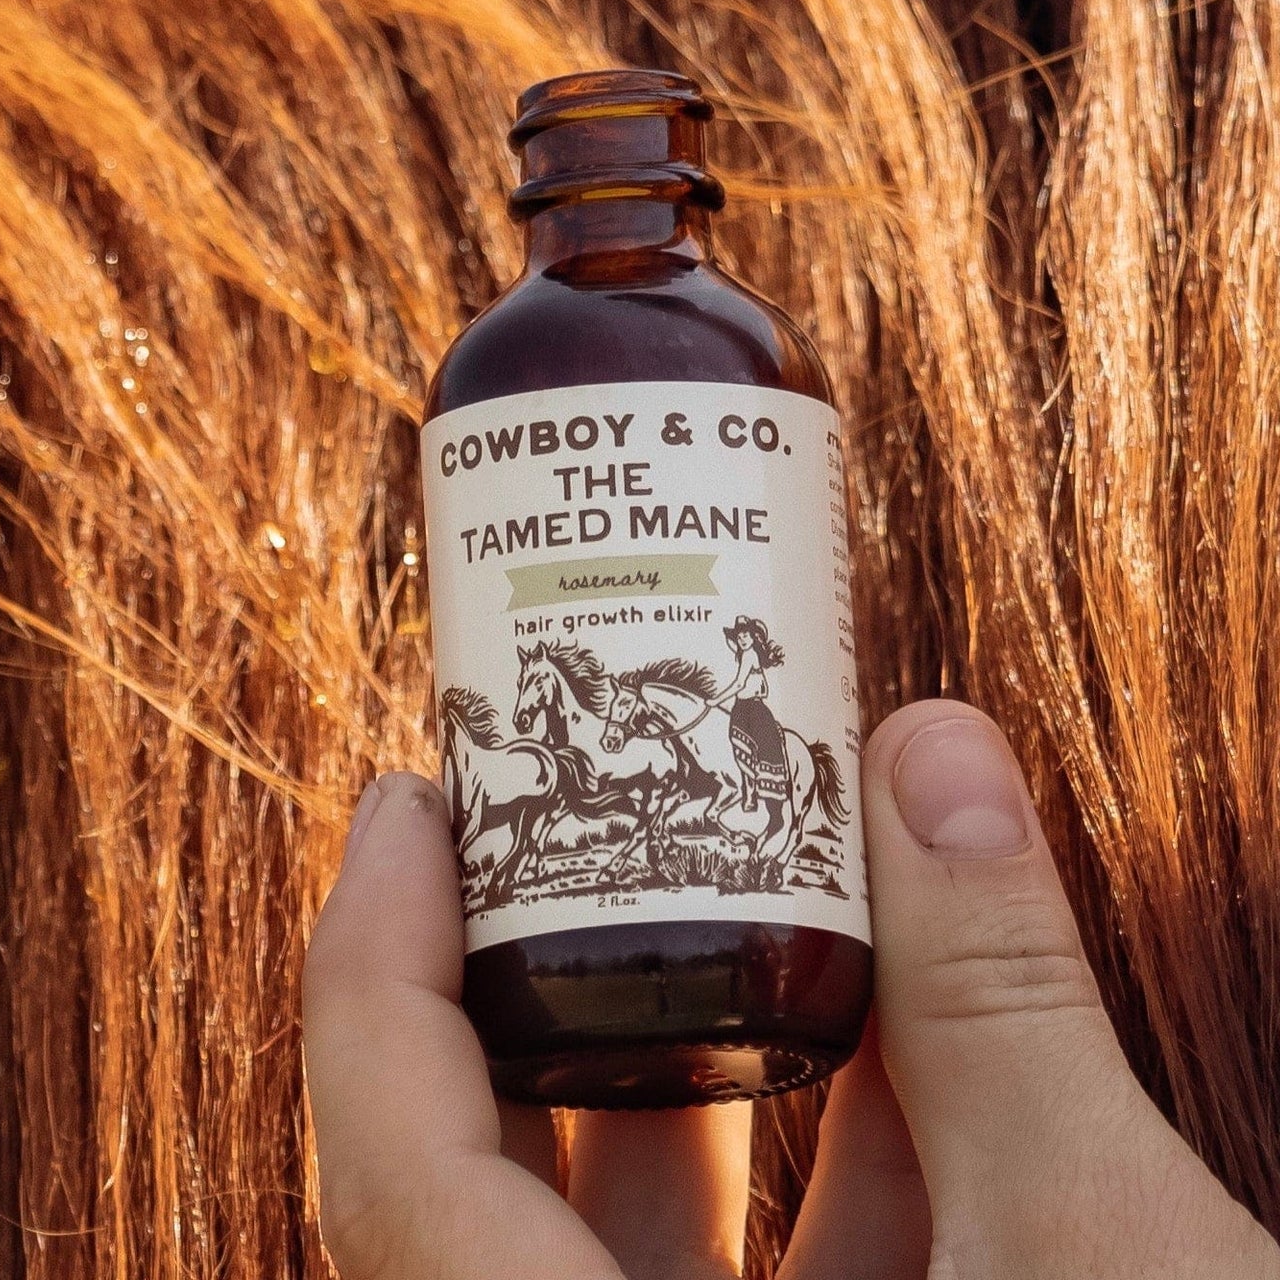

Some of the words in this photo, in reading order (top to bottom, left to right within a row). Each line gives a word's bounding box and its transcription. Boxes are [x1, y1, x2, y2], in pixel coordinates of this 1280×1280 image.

[440, 414, 635, 477] COWBOY
[660, 412, 694, 446] &
[718, 414, 792, 456] CO.
[553, 462, 653, 501] THE
[460, 507, 612, 564] TAMED
[629, 505, 770, 543] MANE
[558, 570, 662, 591] rosemary
[514, 614, 554, 637] hair
[562, 606, 644, 634] growth
[653, 604, 713, 623] elixir
[597, 896, 607, 908] 2
